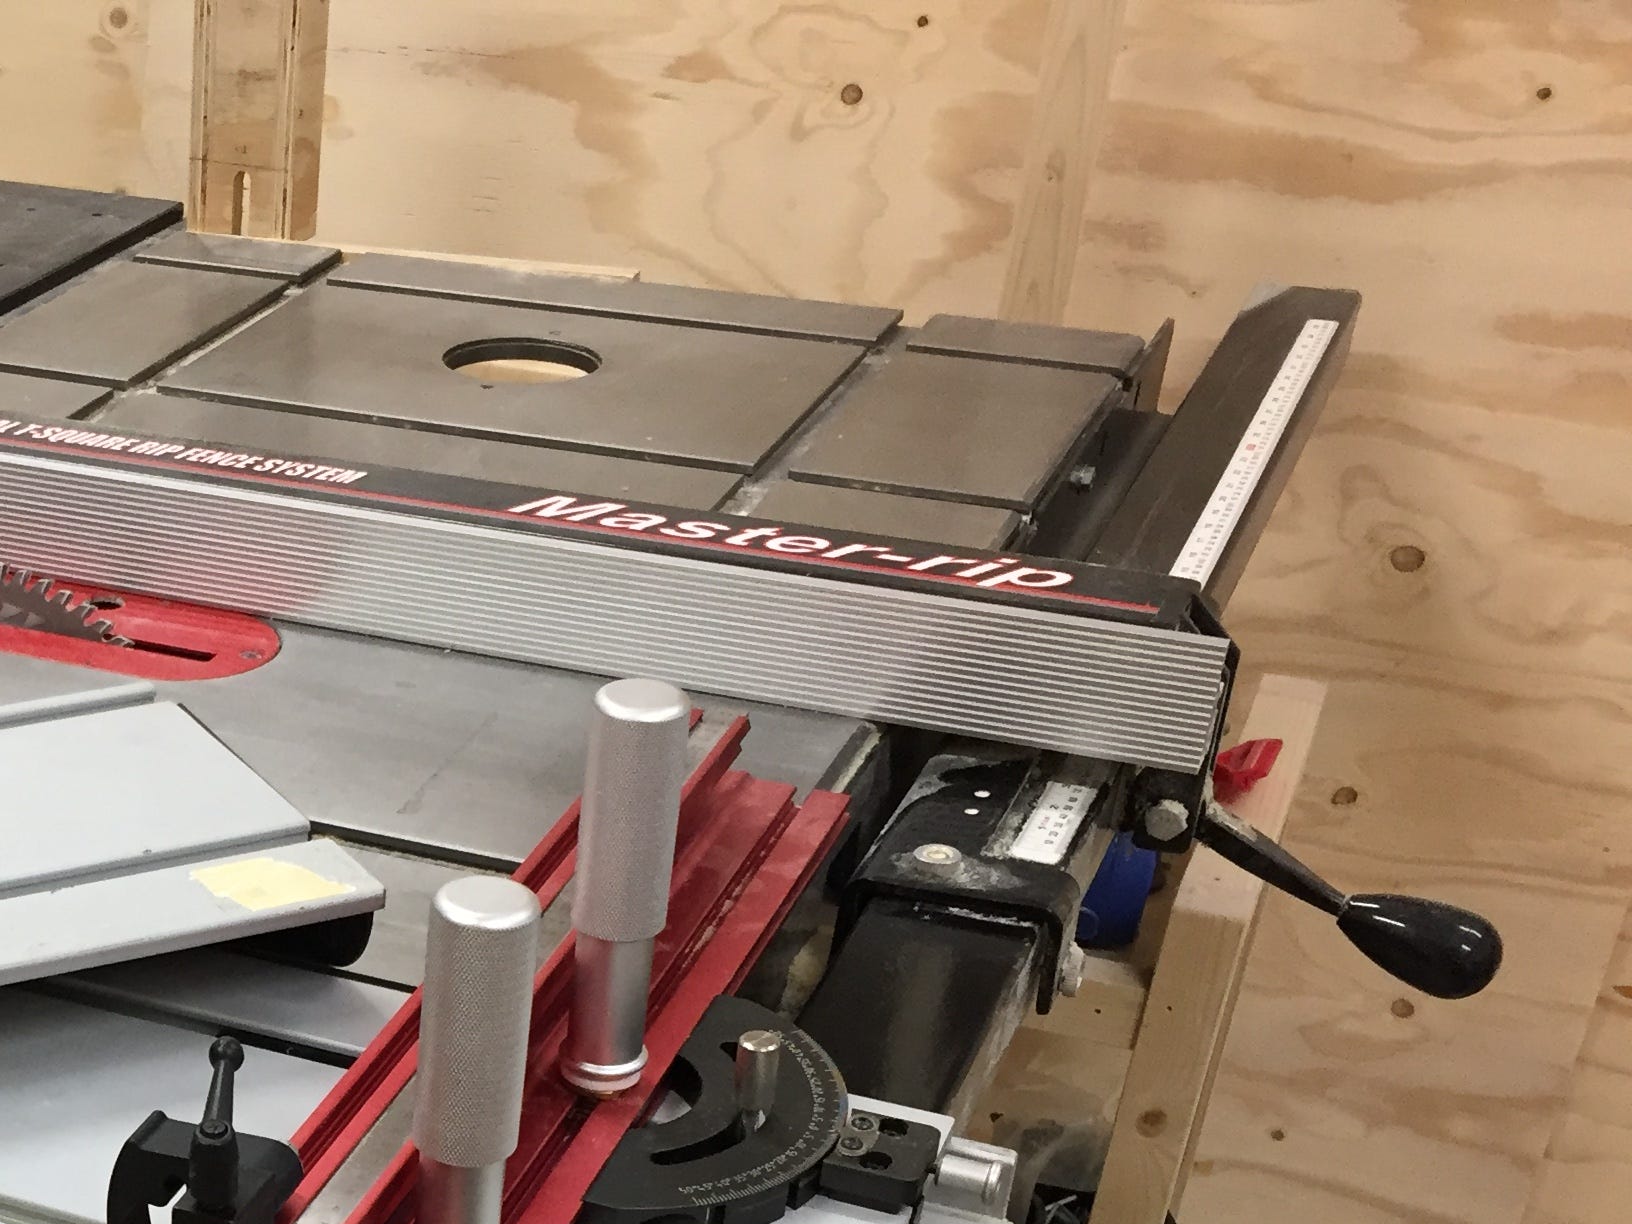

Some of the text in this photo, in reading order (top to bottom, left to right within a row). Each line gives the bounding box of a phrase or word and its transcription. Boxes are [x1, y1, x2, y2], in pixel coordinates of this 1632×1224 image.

[14, 424, 140, 451] T-SQUARE
[128, 440, 185, 457] RIP
[174, 447, 264, 469] FENCE
[255, 458, 368, 484] SYSTEM
[507, 494, 1073, 589] Master-rip
